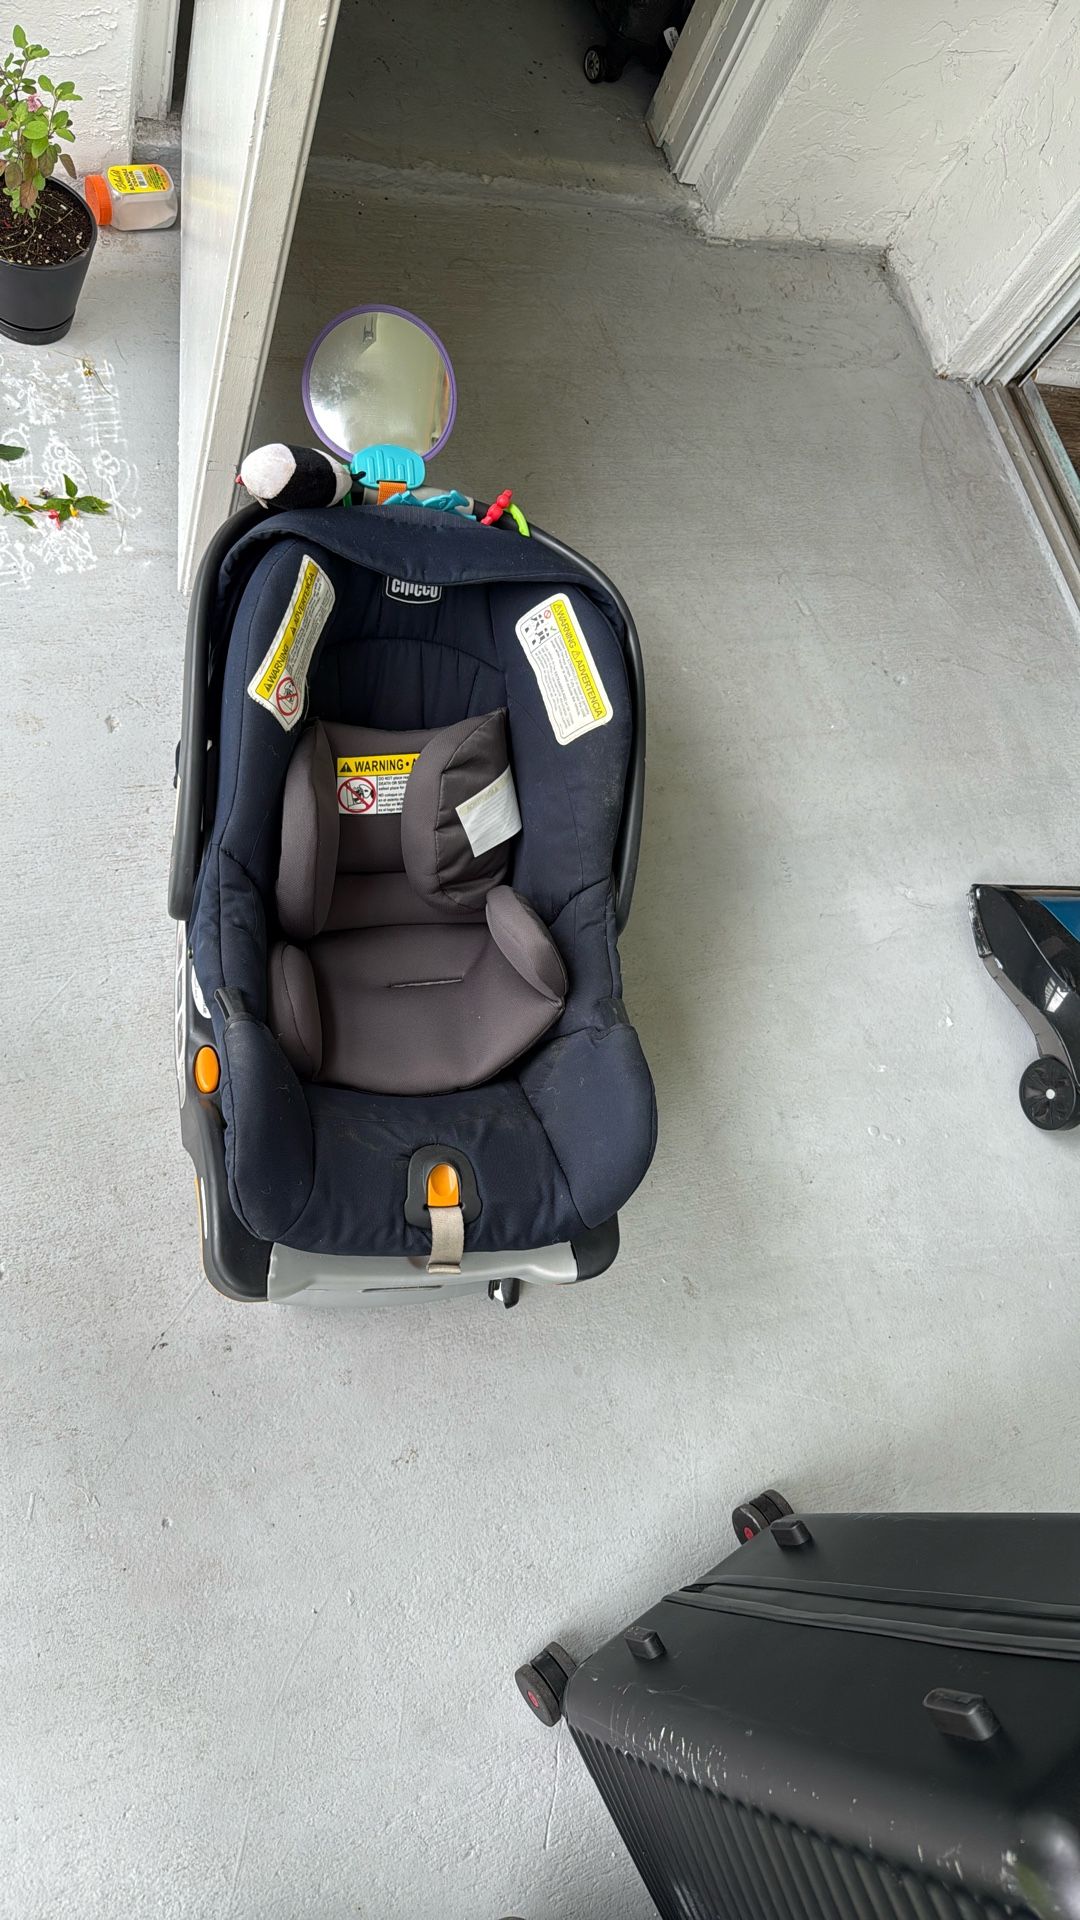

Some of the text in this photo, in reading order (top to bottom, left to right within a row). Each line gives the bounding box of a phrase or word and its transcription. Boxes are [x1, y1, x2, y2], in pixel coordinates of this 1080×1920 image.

[267, 644, 289, 684] WARNING
[294, 572, 316, 627] ADVERTENCIA
[557, 609, 603, 717] WARNING ADVERTENCIA
[354, 759, 404, 773] WARNING
